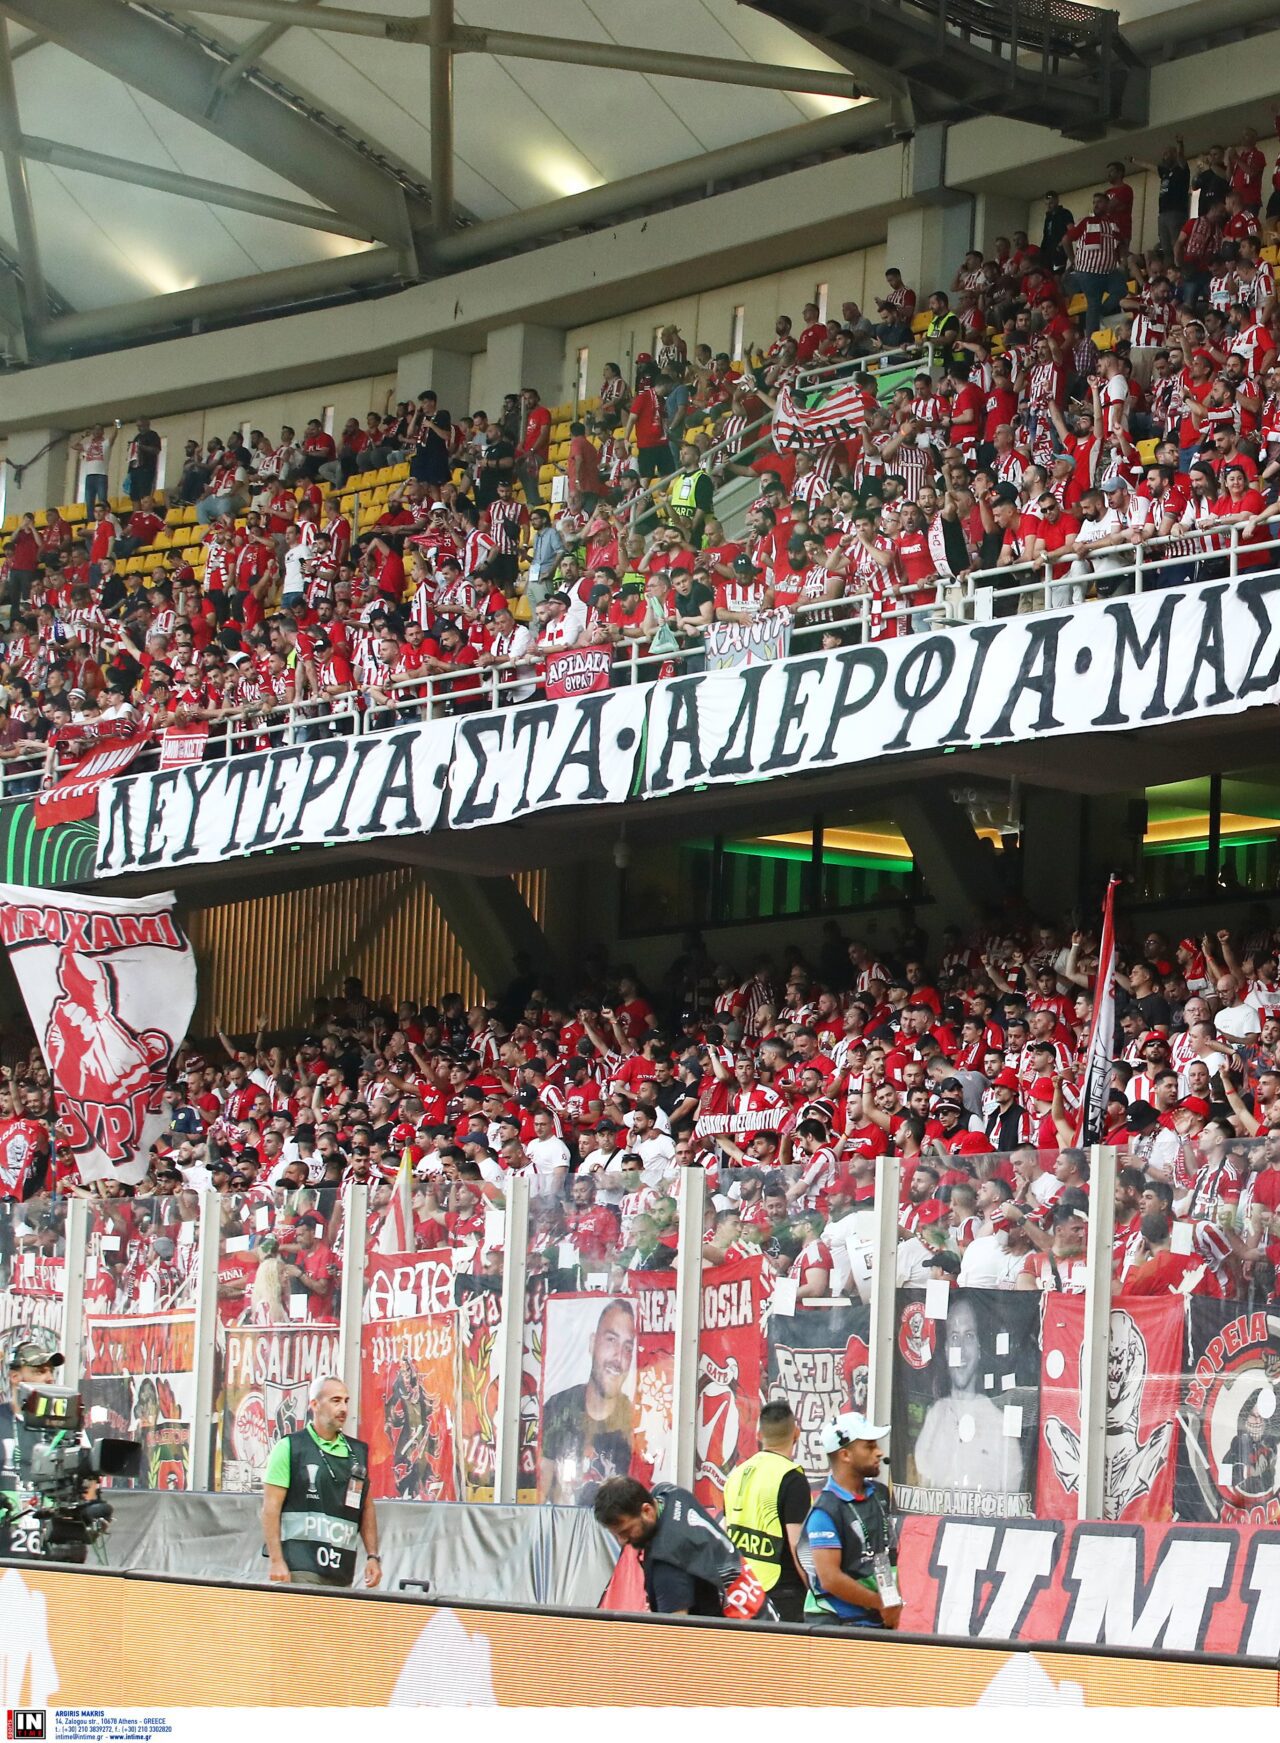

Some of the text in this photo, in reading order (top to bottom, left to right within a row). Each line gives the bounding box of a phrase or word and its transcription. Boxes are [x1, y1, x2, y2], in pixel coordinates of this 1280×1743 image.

[460, 692, 616, 820] ΣΤΑ
[650, 612, 1074, 788] ΑΔΕΡΦΙΑ
[706, 1363, 728, 1383] GATE
[10, 1530, 43, 1554] 26
[304, 1516, 354, 1545] PITCH
